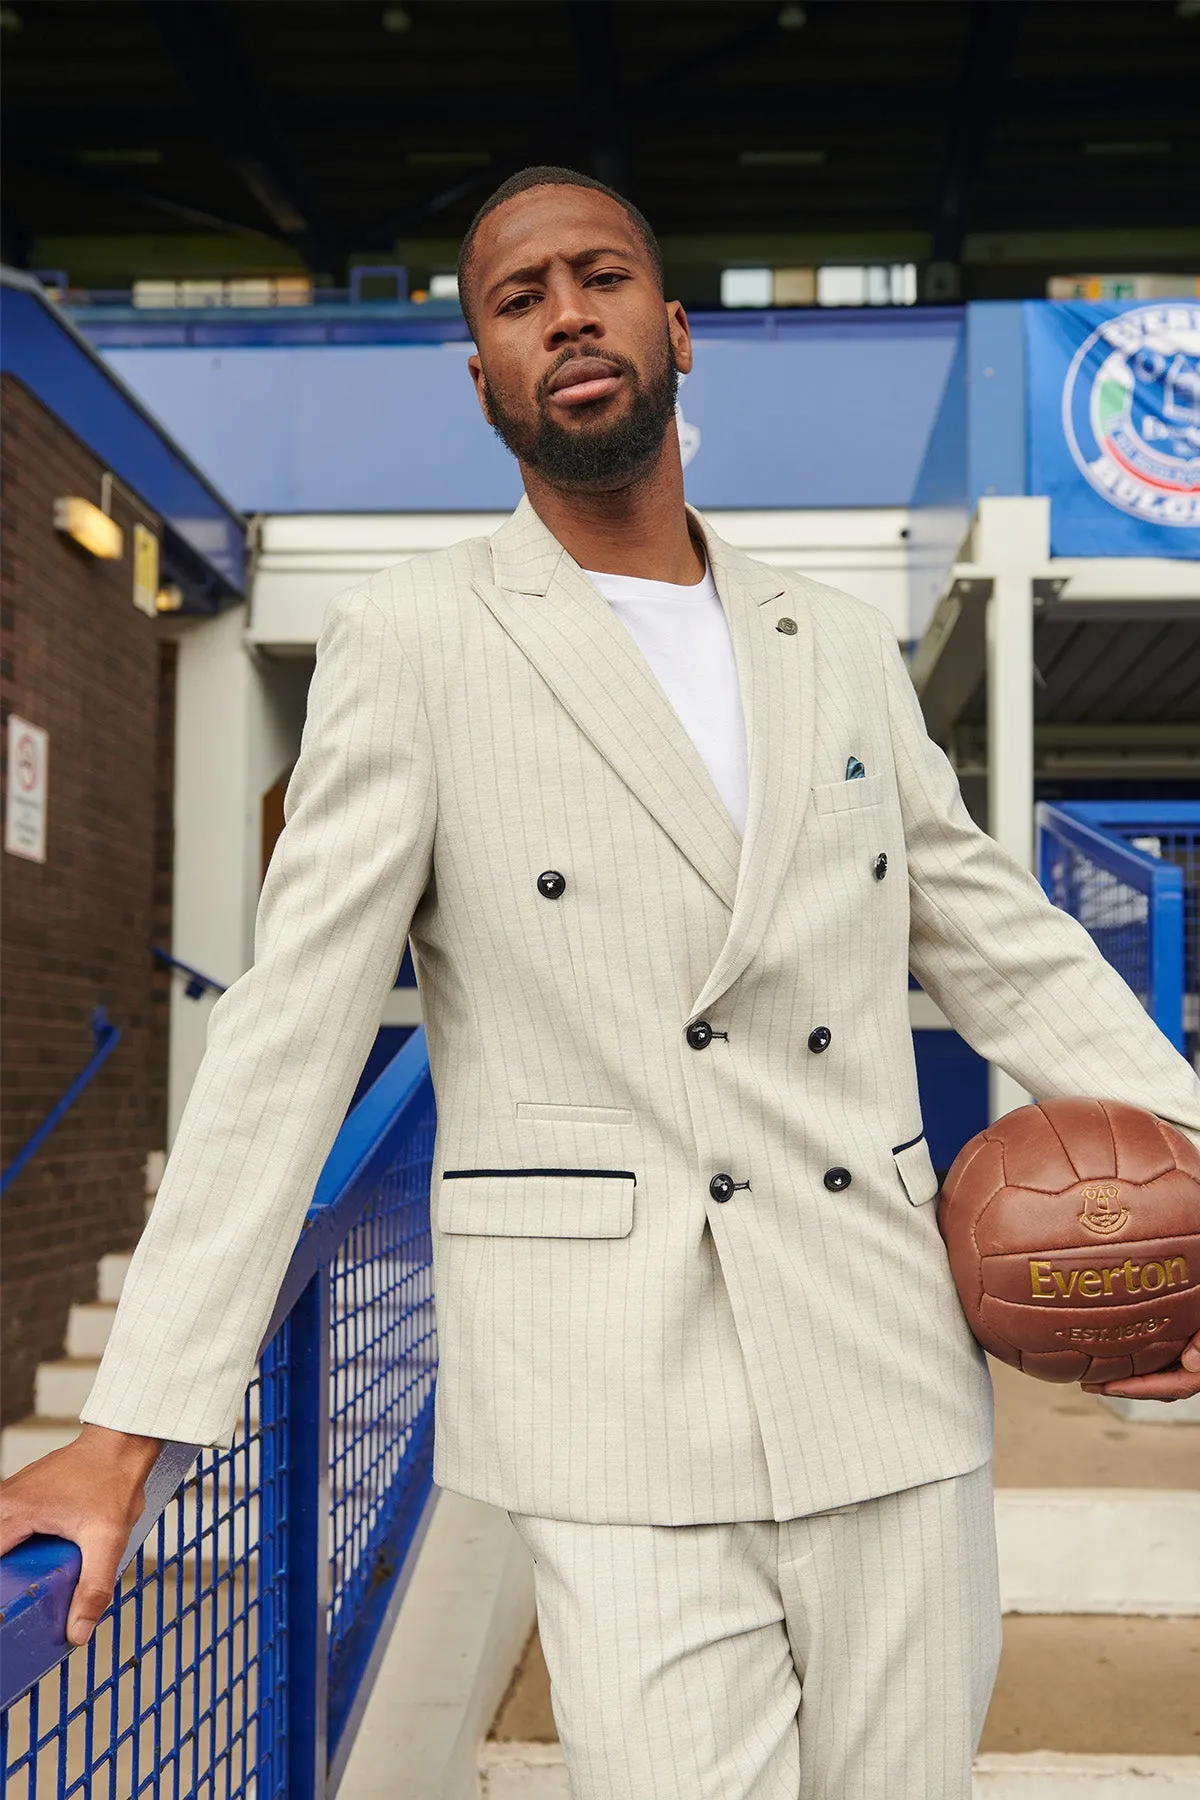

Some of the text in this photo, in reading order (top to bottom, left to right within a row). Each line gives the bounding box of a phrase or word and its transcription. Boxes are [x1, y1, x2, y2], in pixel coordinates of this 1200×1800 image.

[1100, 308, 1200, 350] EVER
[1089, 456, 1200, 523] BULG
[1029, 1255, 1189, 1298] Everton
[1069, 1326, 1110, 1341] EST.
